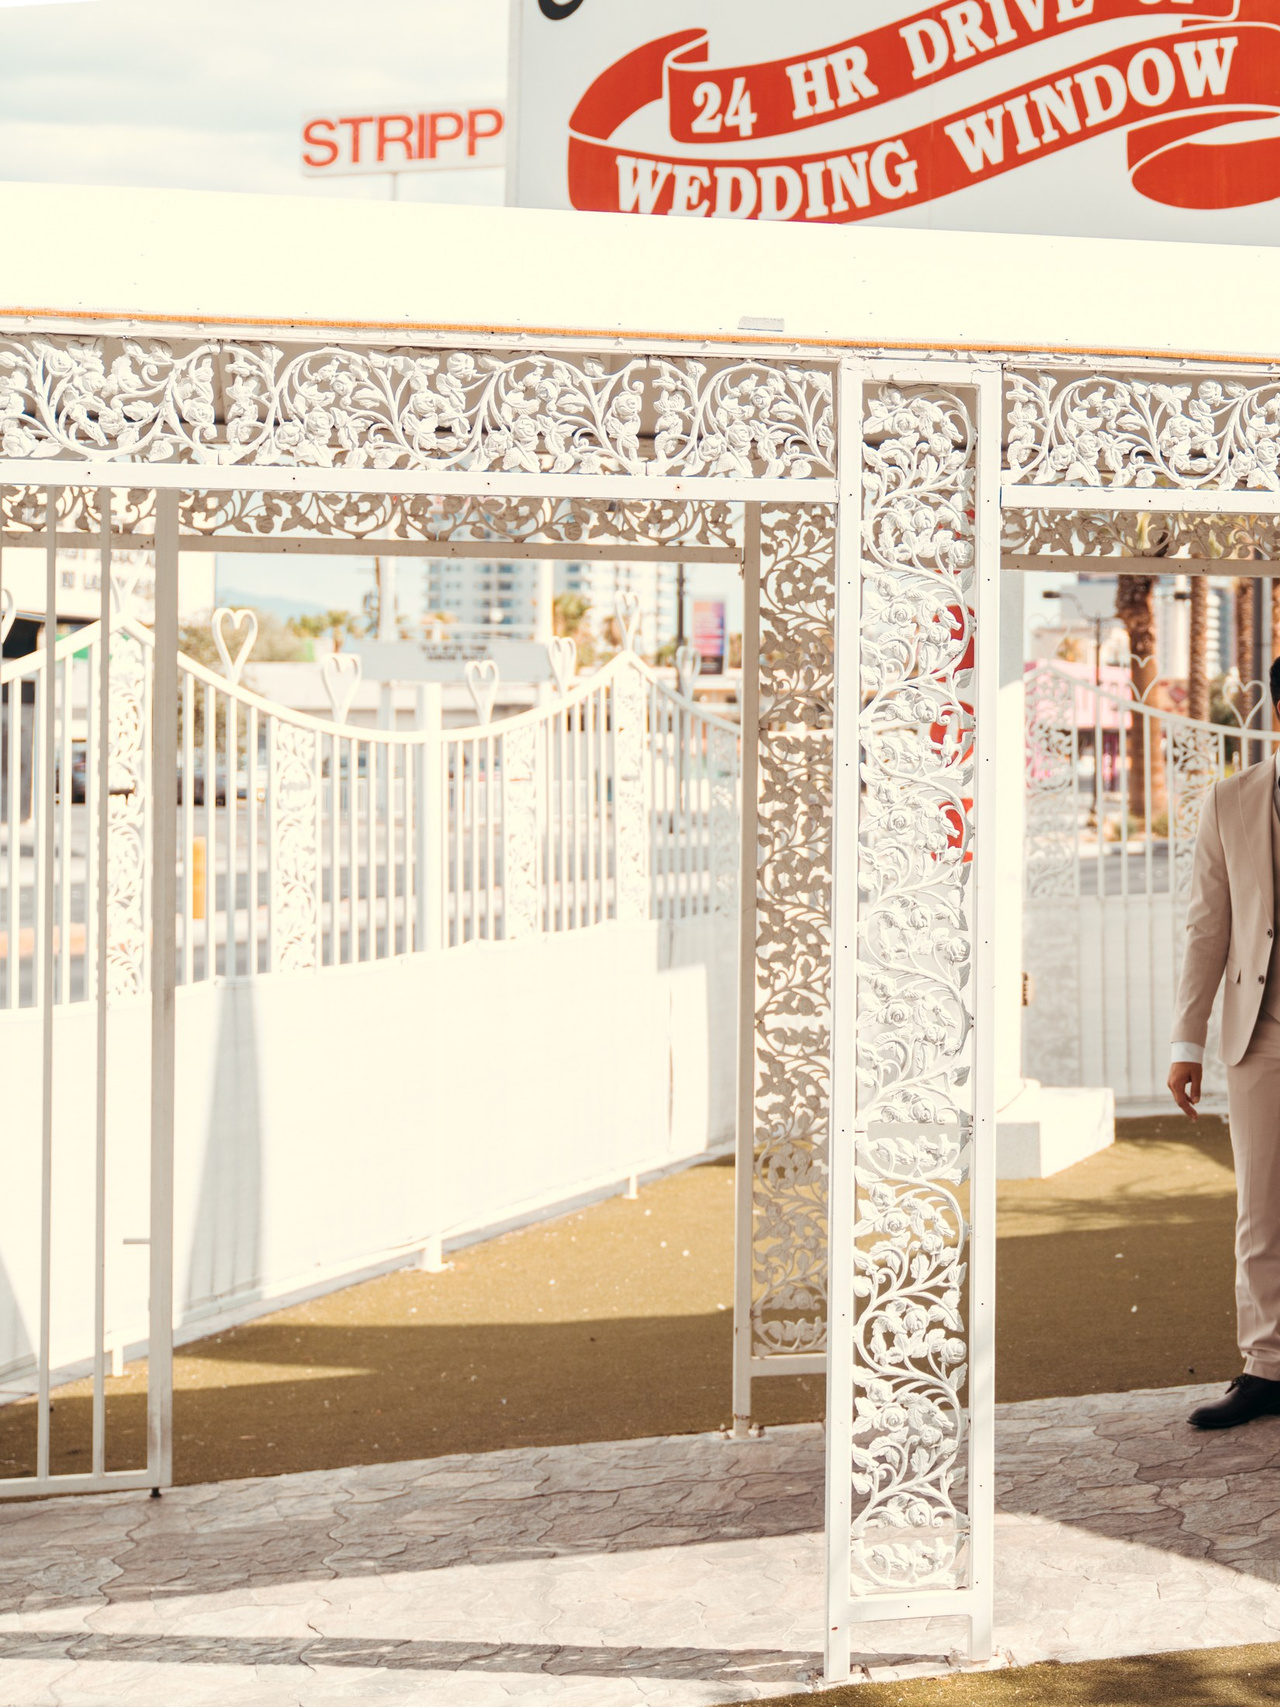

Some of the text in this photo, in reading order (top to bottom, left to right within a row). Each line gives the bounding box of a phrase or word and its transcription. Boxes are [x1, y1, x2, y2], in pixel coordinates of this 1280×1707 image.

[615, 36, 1239, 221] WEDDING WINDOW
[690, 77, 757, 137] 24
[786, 45, 879, 120] HR
[302, 107, 505, 168] STRIPP
